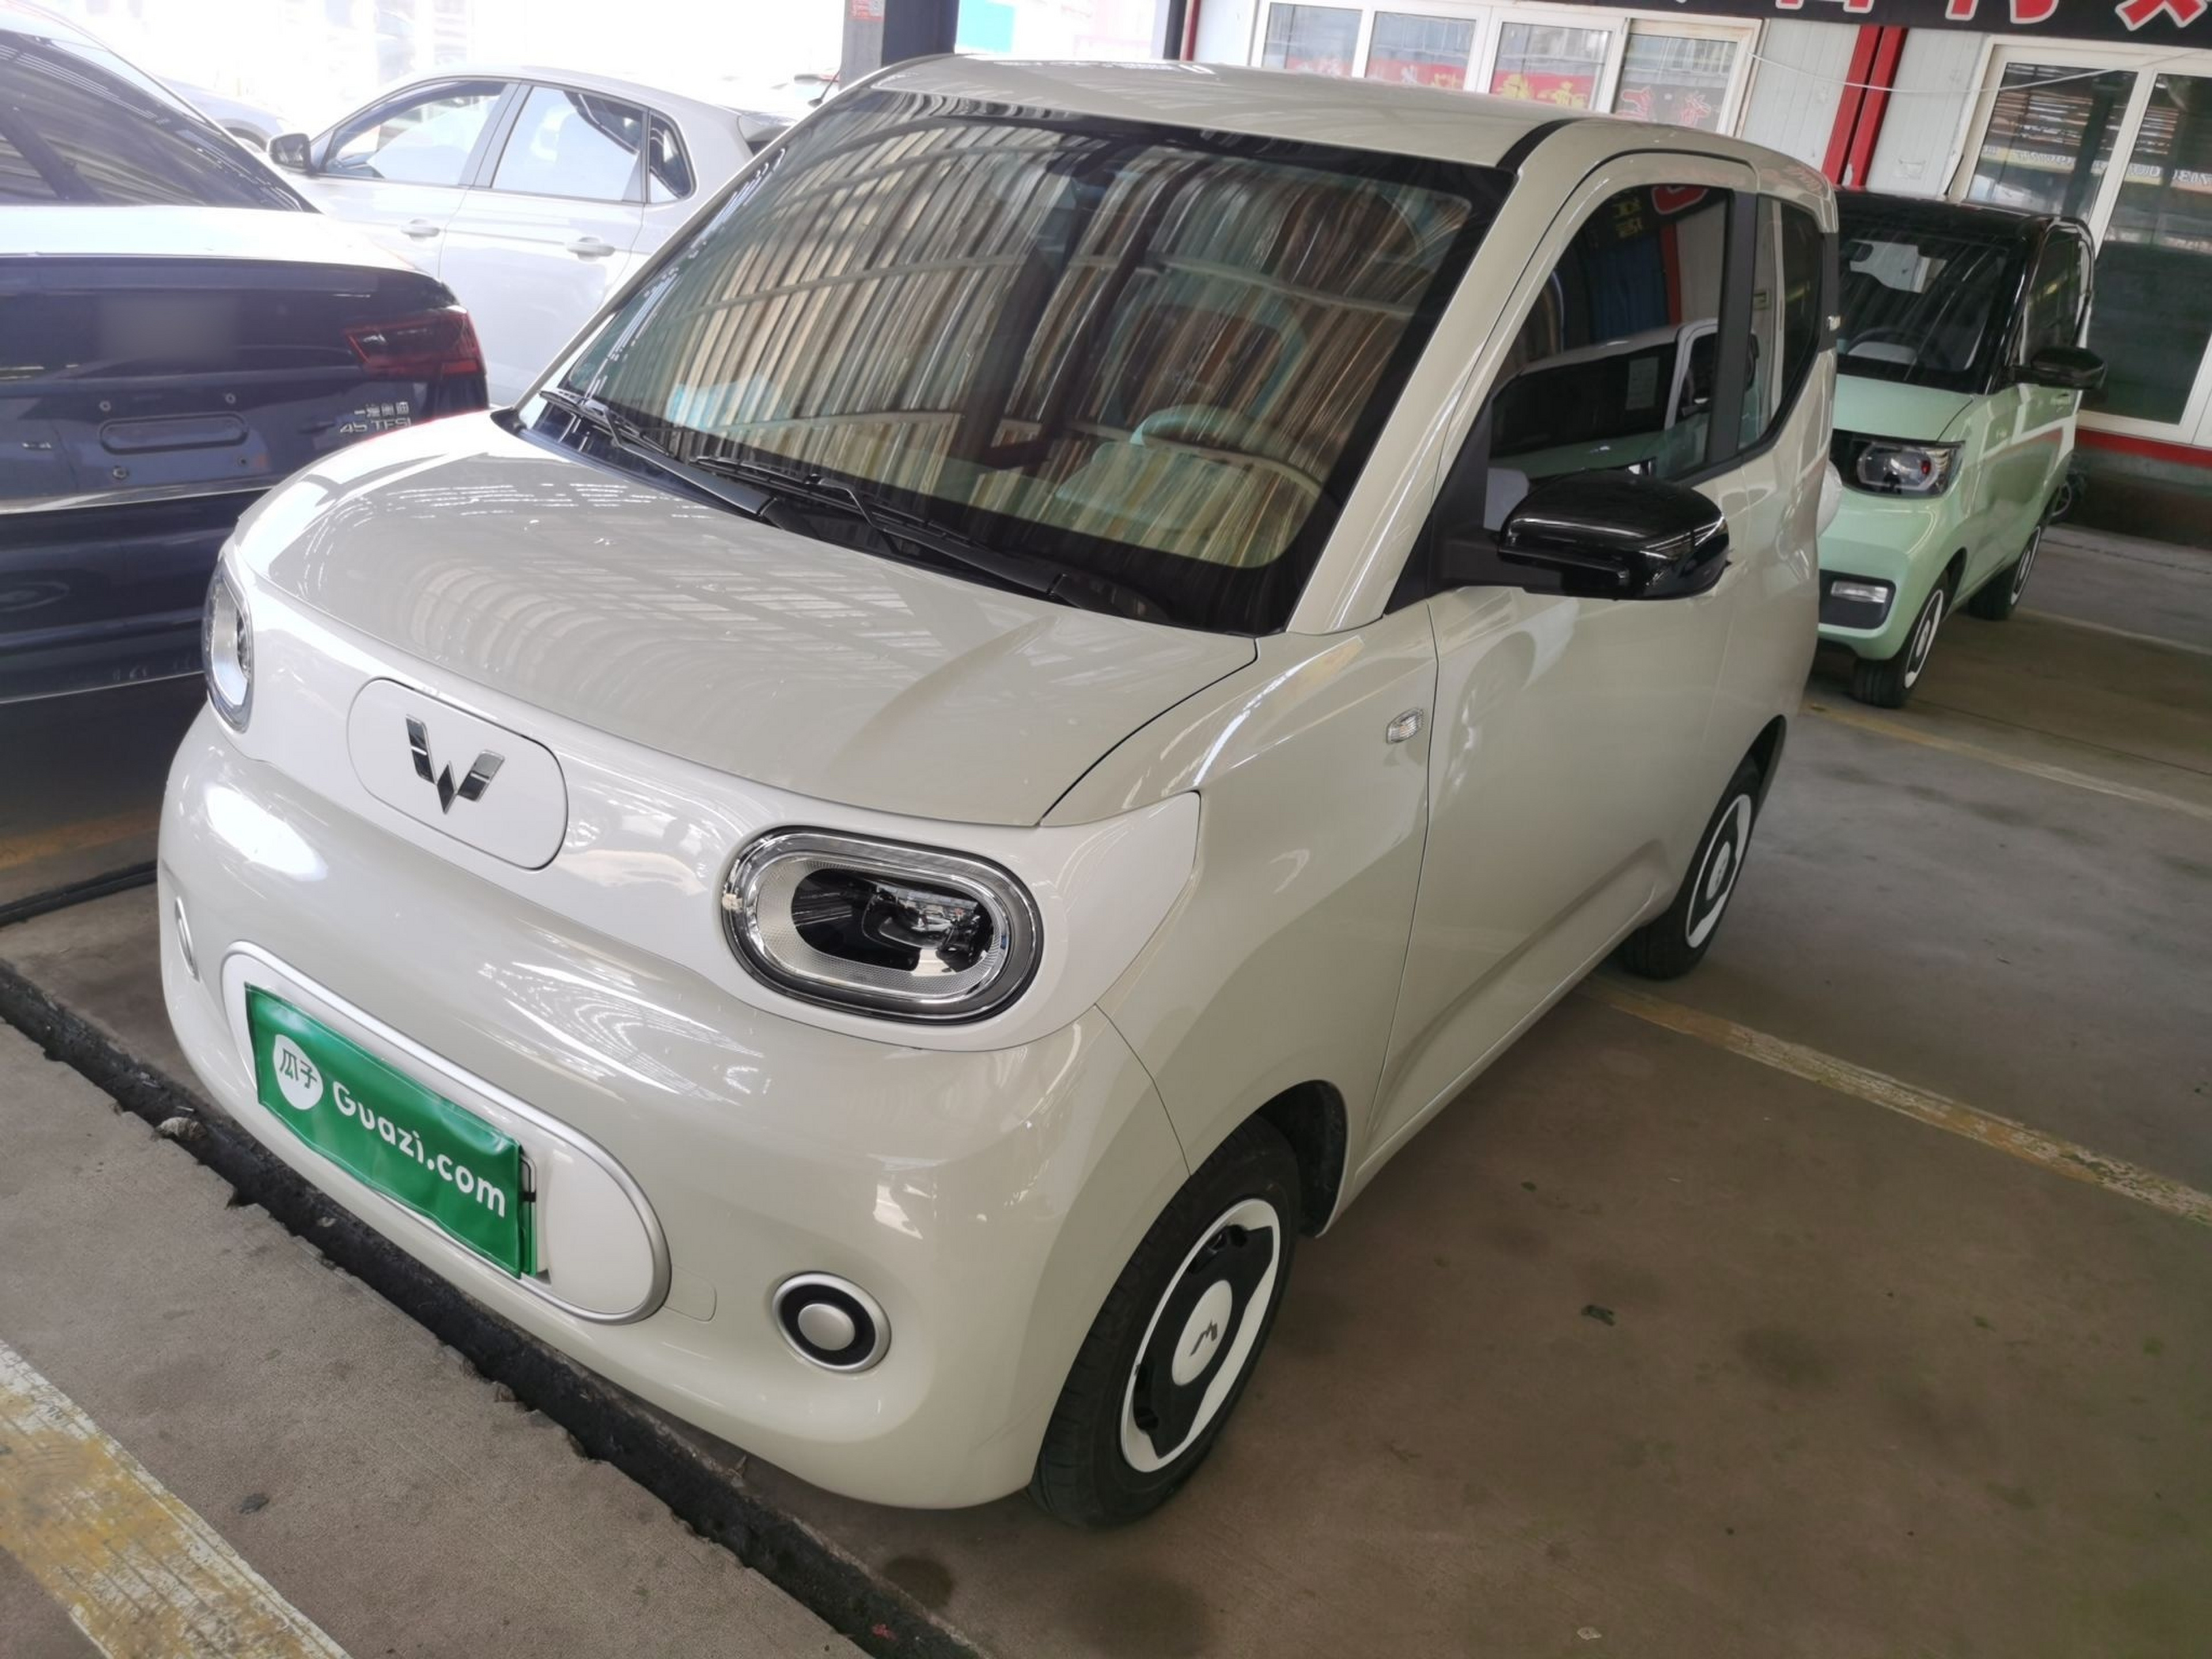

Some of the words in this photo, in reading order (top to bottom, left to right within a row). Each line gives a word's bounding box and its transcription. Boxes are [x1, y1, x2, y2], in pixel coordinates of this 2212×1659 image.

[340, 421, 368, 433] 45
[370, 416, 411, 431] TFSI
[279, 1048, 317, 1089] 瓜子
[333, 1081, 505, 1218] Guazi.com
